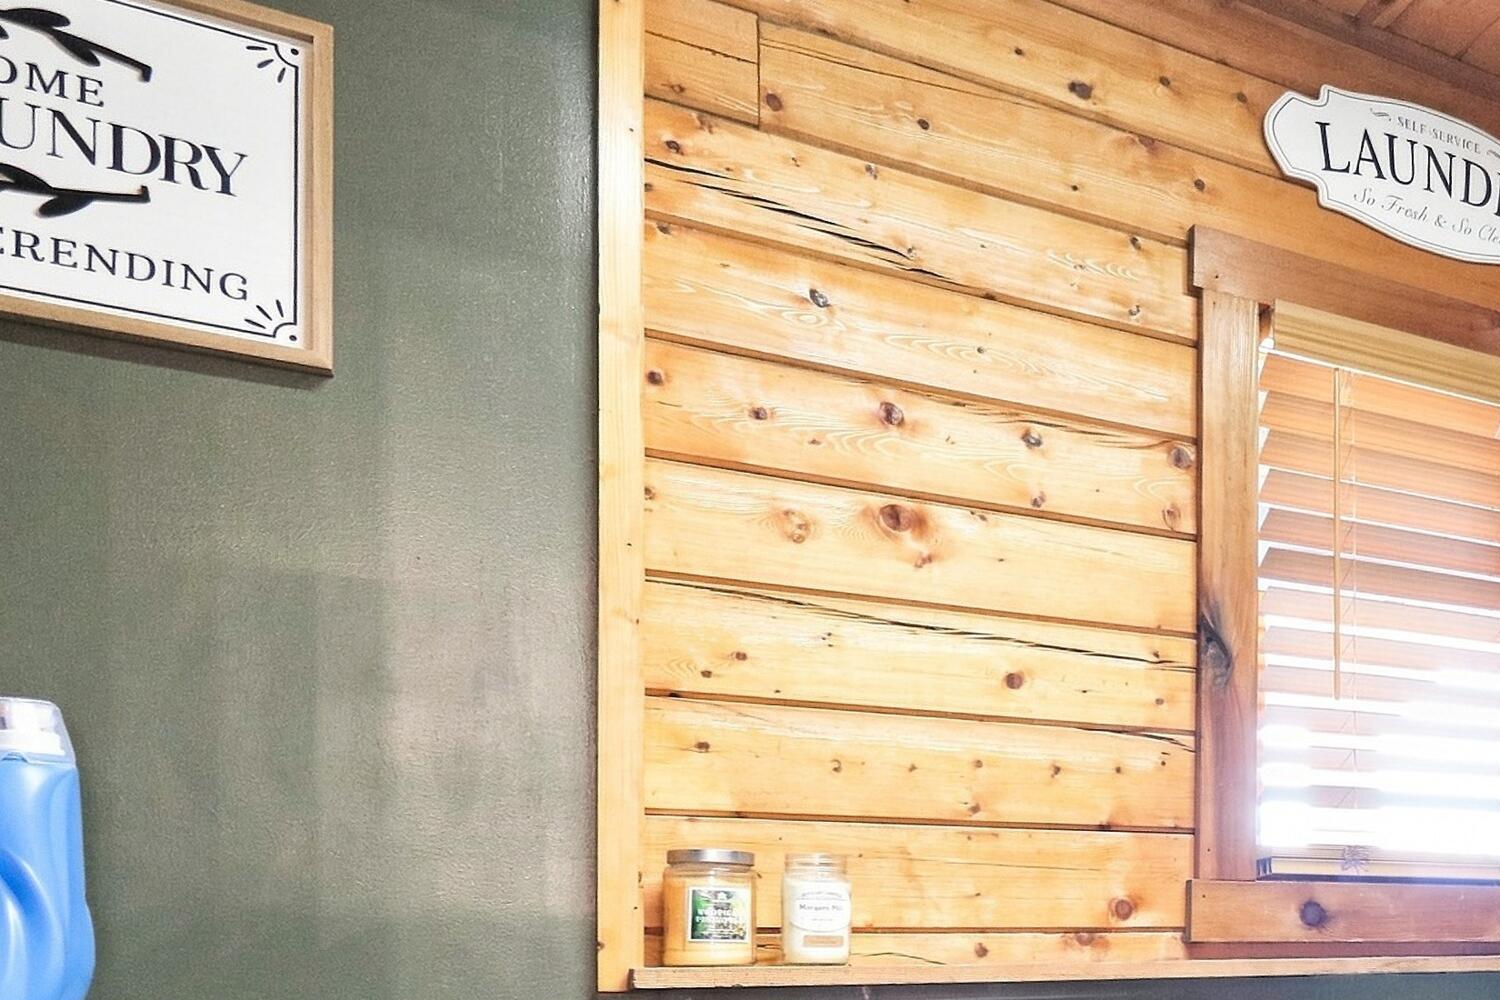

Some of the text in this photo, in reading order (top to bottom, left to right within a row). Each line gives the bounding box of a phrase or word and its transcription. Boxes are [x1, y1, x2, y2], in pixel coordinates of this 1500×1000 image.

[0, 97, 248, 197] UNDRY
[1353, 187, 1376, 207] So
[1381, 194, 1428, 222] Fresh
[1434, 214, 1448, 228] &
[1452, 217, 1472, 236] So
[0, 226, 249, 301] RENDING
